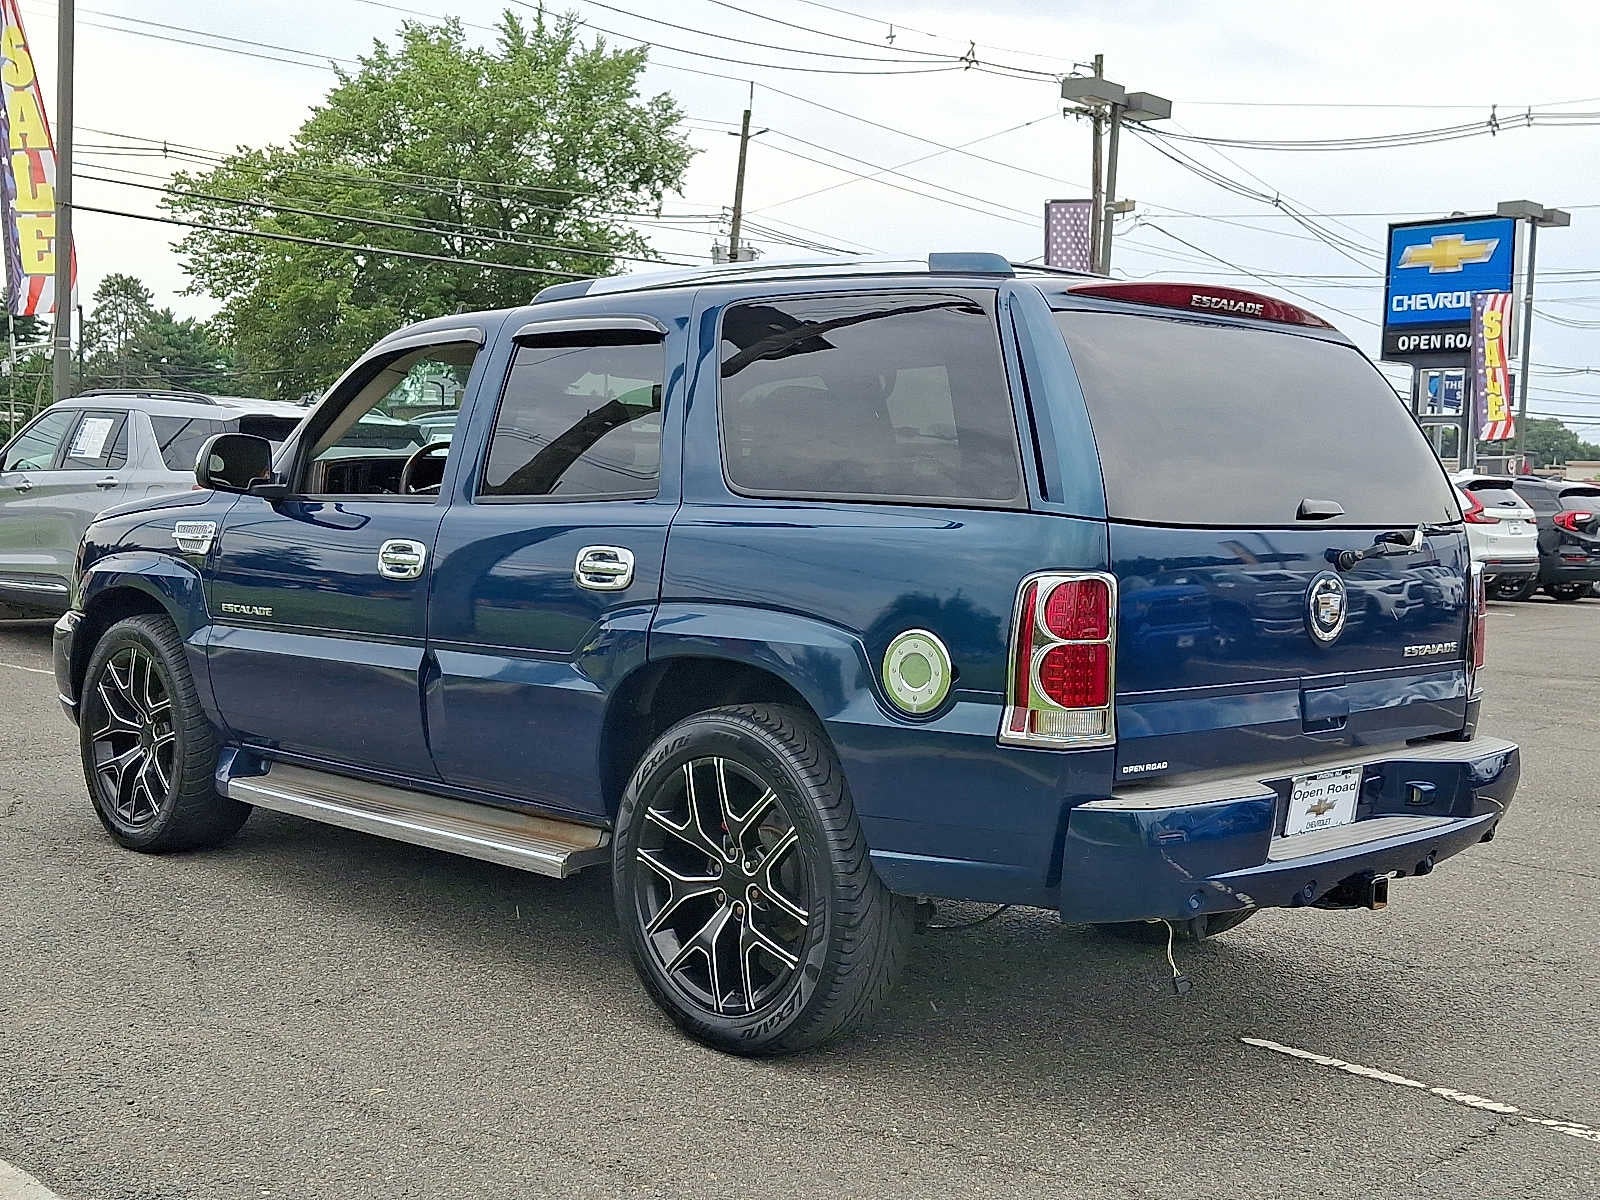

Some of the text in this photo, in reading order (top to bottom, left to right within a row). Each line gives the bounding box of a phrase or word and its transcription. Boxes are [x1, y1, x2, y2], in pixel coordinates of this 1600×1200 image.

[2, 24, 55, 275] SALE
[1191, 294, 1263, 315] ESCALADE
[1393, 291, 1472, 311] CHEVROL
[1398, 334, 1441, 351] OPEN
[1483, 310, 1506, 422] SALE
[221, 602, 273, 617] ESCALADE
[1403, 642, 1458, 657] ESCALADE
[1122, 761, 1168, 774] OPEN ROAD
[1293, 780, 1357, 802] Open Road
